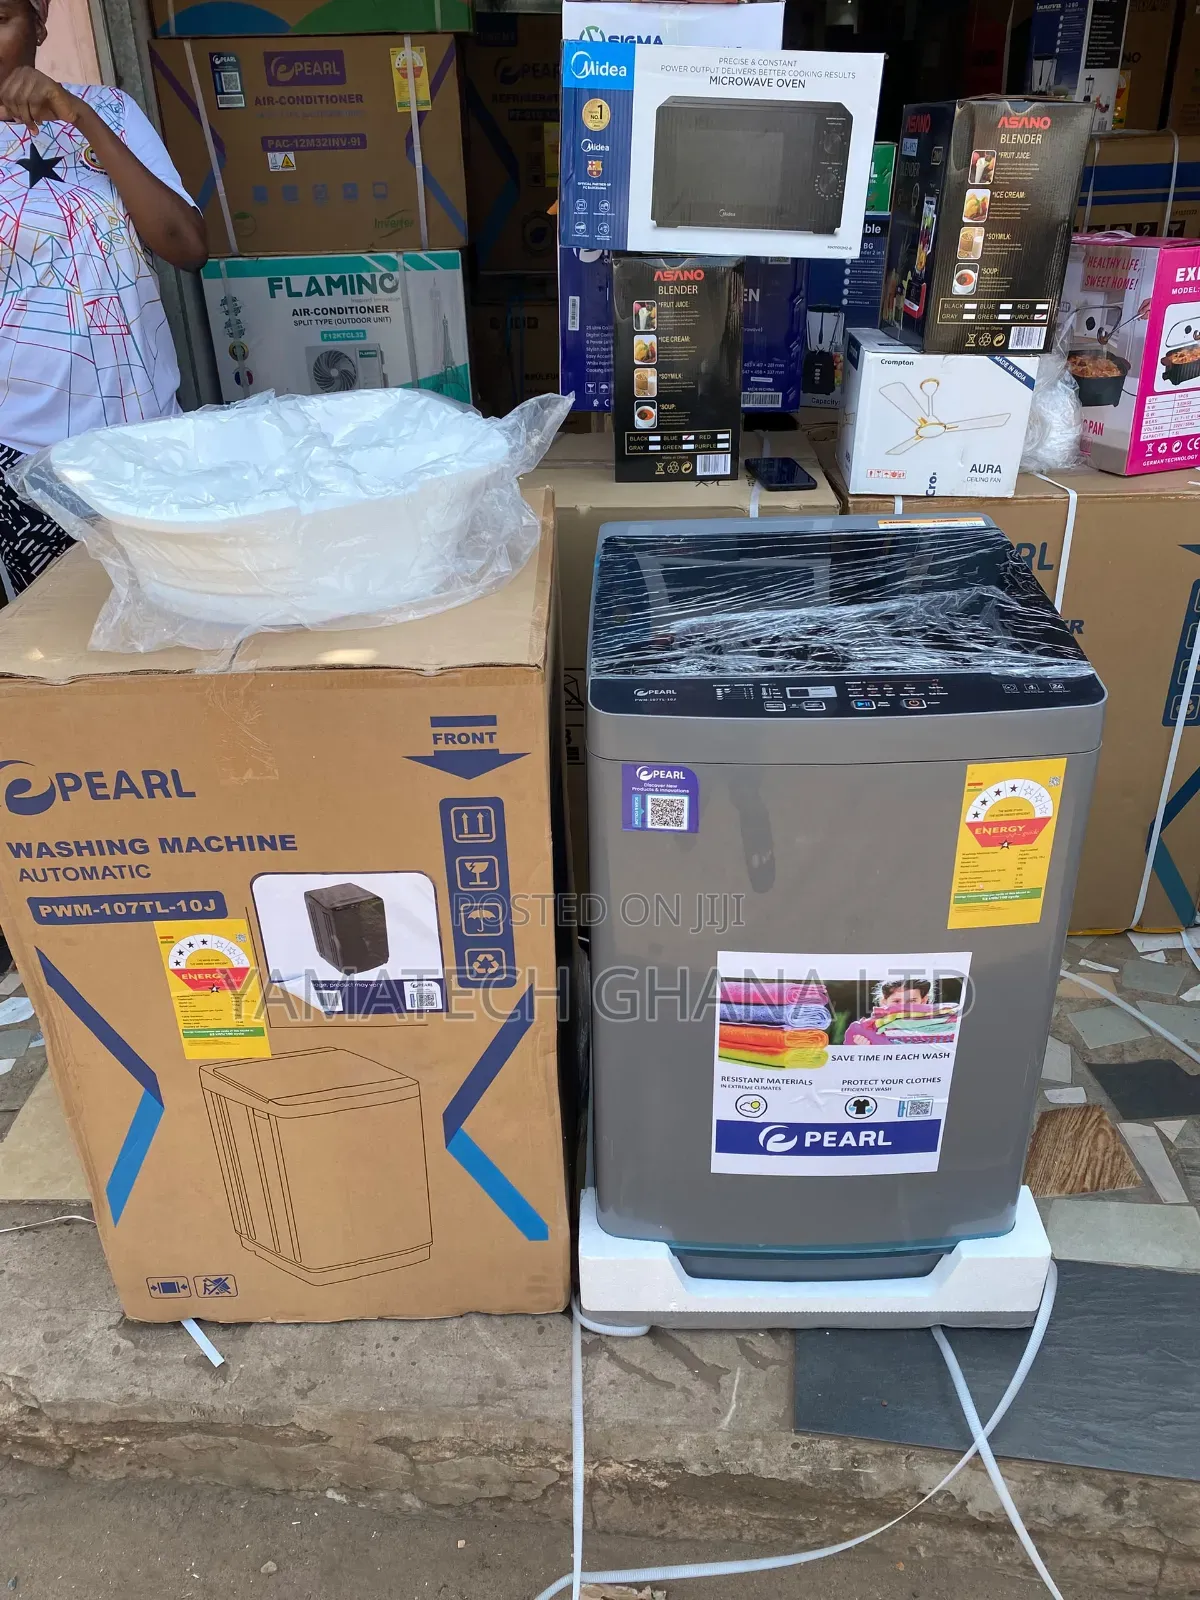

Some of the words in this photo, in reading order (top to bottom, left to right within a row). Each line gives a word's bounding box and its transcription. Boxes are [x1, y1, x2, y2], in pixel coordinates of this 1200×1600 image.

[294, 60, 340, 76] PEARL
[571, 51, 627, 79] Midea
[718, 58, 749, 66] PRECISE
[750, 58, 756, 66] &
[757, 59, 798, 67] CONSTANT
[660, 64, 688, 73] POWER
[690, 66, 720, 74] OUTPUT
[722, 67, 757, 76] DELIVERS
[758, 68, 787, 76] BETTER
[788, 70, 822, 78] COOKING
[824, 71, 856, 80] RESULTS
[709, 76, 773, 88] MICROWAVE
[776, 78, 806, 88] OVEN
[254, 94, 364, 106] AIR-CONDITIONER
[598, 104, 602, 120] 1
[998, 116, 1052, 130] ASANO
[581, 138, 610, 152] Midea
[1000, 134, 1042, 144] BLENDER
[862, 224, 882, 234] ble
[1087, 255, 1120, 270] HEALTHY
[1122, 257, 1142, 272] LIFE,
[654, 269, 704, 282] ASANO
[1084, 276, 1111, 288] SWEET
[1112, 277, 1139, 290] HOME!
[658, 285, 698, 294] BLENDER
[1172, 286, 1200, 294] MODEL:
[292, 305, 390, 316] AIR-CONDITIONER
[334, 318, 372, 326] (OUTDOOR
[373, 316, 392, 324] UNIT)
[880, 358, 914, 367] Crompton
[994, 356, 1009, 368] MADE
[1008, 364, 1014, 372] IN
[1013, 369, 1026, 382] INDIA
[1088, 420, 1104, 436] PAN
[1142, 458, 1164, 466] GERMAN
[1164, 454, 1198, 463] TECHNOLOGY
[970, 464, 1002, 474] AURA
[432, 732, 498, 746] FRONT
[654, 770, 686, 780] PEARL
[55, 768, 197, 802] PEARL
[974, 824, 1026, 836] ENERGY
[6, 838, 150, 858] WASHING
[158, 834, 298, 854] MACHINE
[18, 864, 152, 883] AUTOMATIC
[38, 899, 216, 918] PWM-107TL-10J
[181, 972, 228, 981] ENERGY
[831, 1054, 854, 1062] SAVE
[895, 1052, 920, 1060] EACH
[922, 1052, 950, 1060] WASH
[721, 1075, 766, 1084] RESISTANT
[767, 1077, 813, 1086] MATERIALS
[842, 1078, 879, 1086] PROTECT
[880, 1077, 904, 1085] YOUR
[905, 1076, 941, 1084] CLOTHES
[804, 1130, 892, 1148] PEARL
